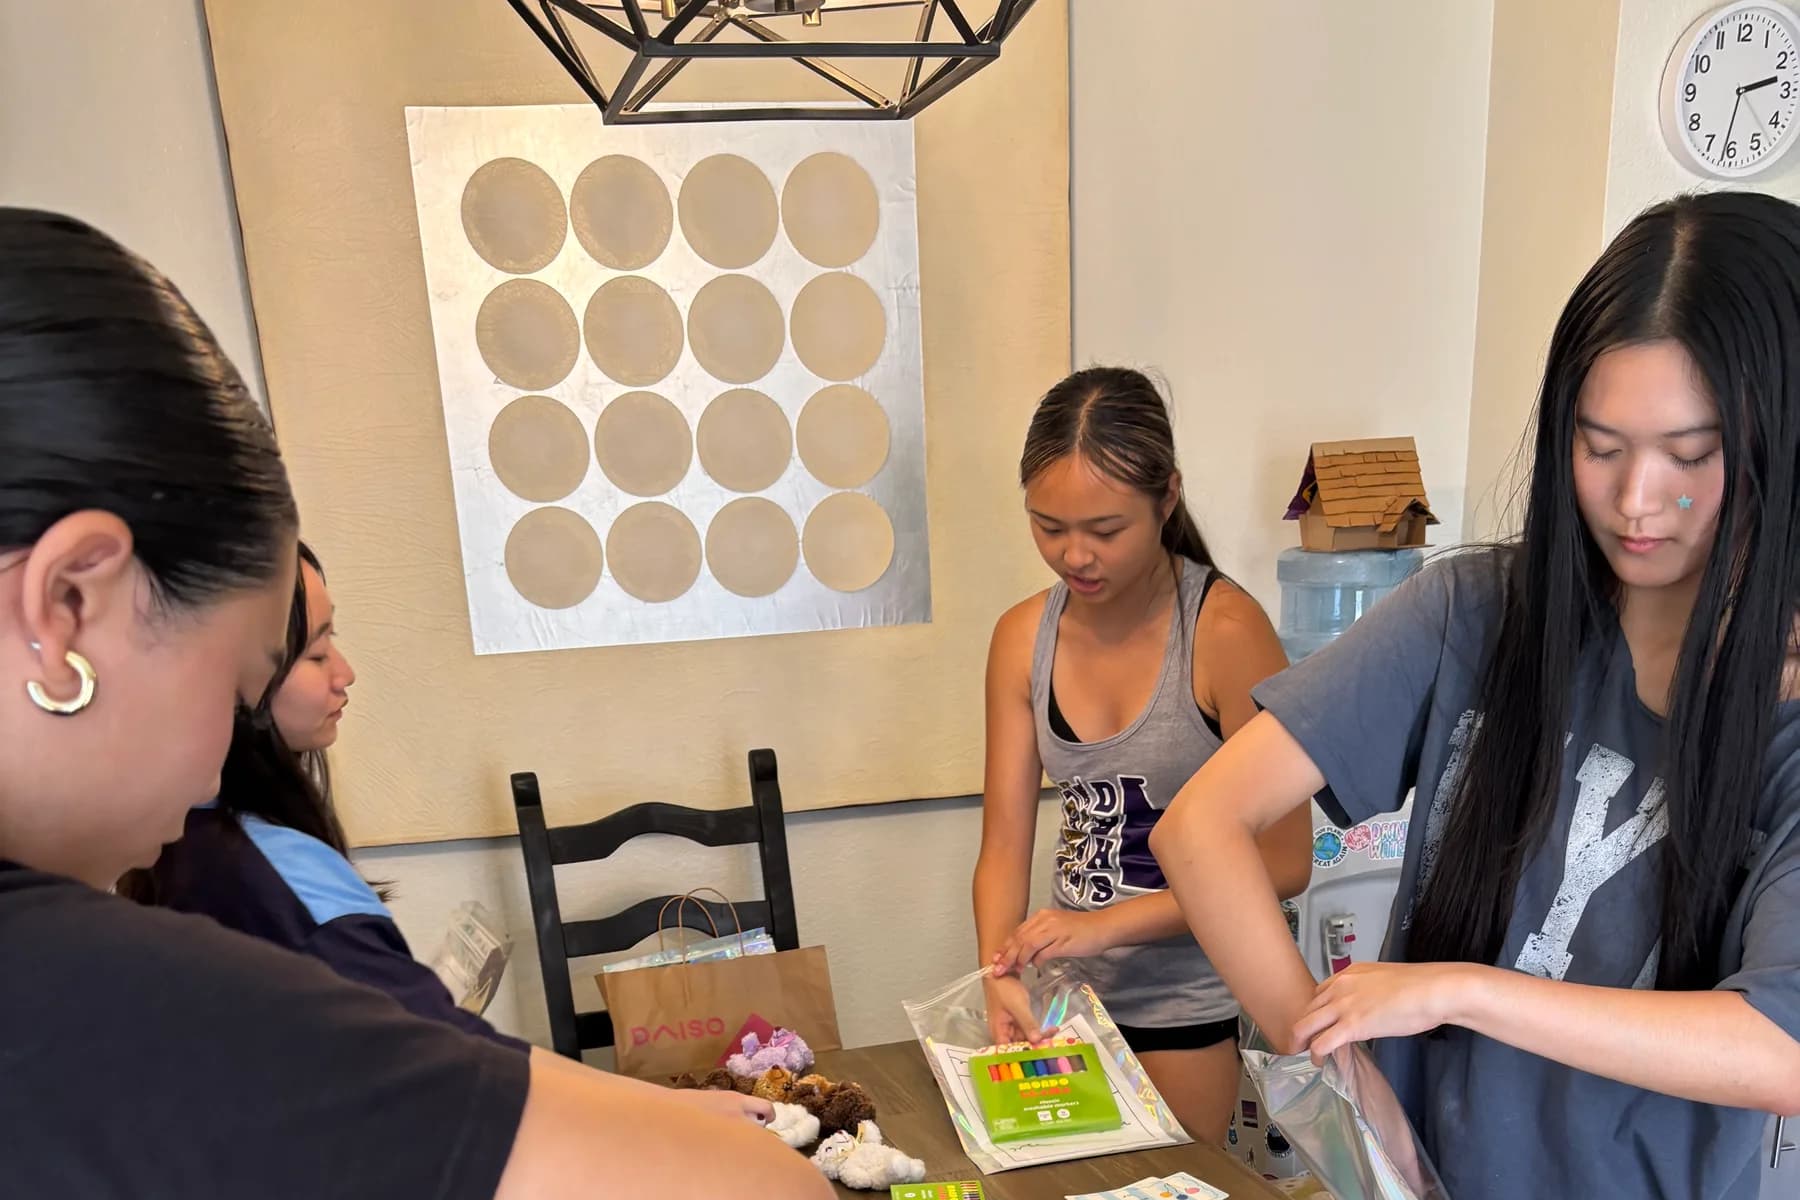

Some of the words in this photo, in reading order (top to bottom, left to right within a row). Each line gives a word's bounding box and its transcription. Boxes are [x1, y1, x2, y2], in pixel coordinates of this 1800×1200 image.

[1716, 31, 1725, 50] 11
[1737, 23, 1753, 42] 12
[1764, 30, 1770, 48] 1
[1694, 54, 1711, 73] 10
[1776, 51, 1788, 70] 2
[1684, 83, 1696, 102] 9
[1779, 81, 1791, 99] 3
[1688, 113, 1700, 131] 8
[1769, 111, 1780, 129] 4
[1705, 134, 1716, 152] 7
[1726, 141, 1737, 159] 6
[1750, 133, 1761, 151] 5
[1332, 846, 1348, 865] AGAIN
[1369, 841, 1405, 859] WATE
[631, 1017, 725, 1047] DAISO
